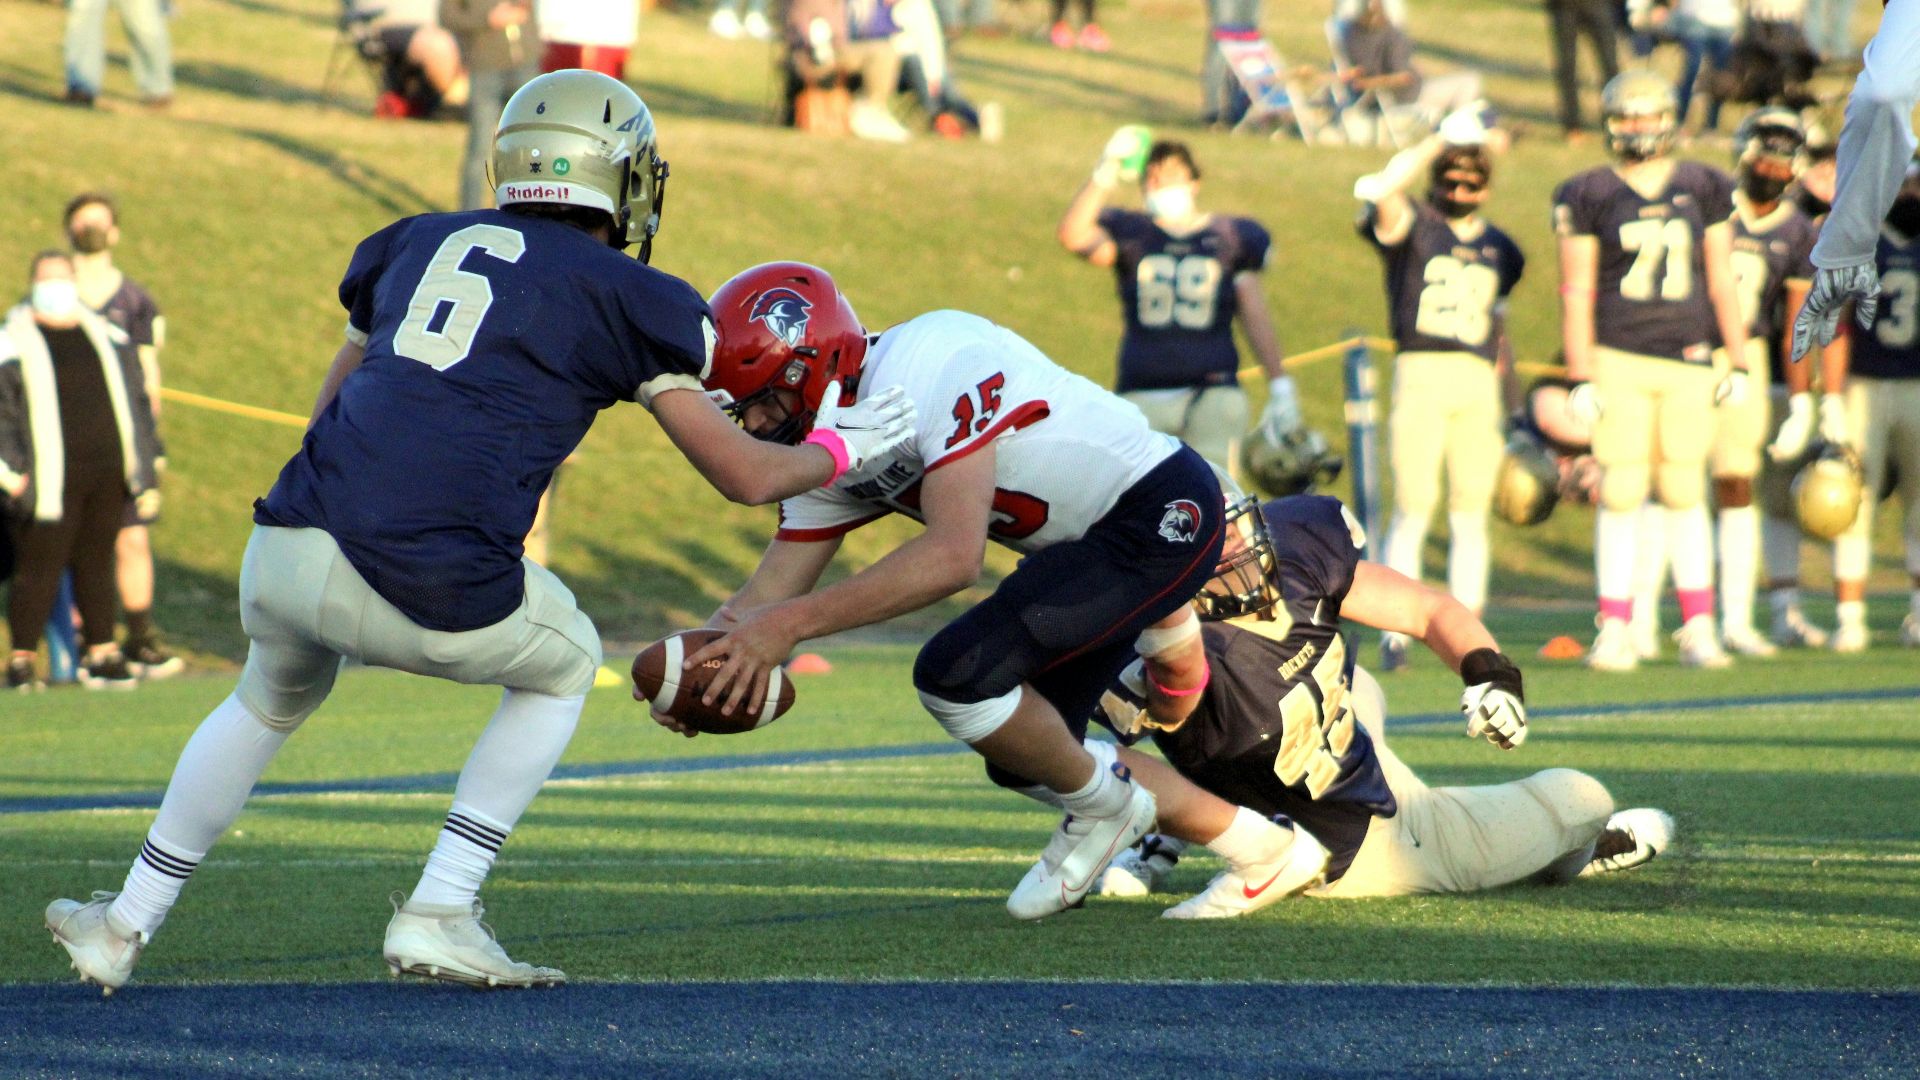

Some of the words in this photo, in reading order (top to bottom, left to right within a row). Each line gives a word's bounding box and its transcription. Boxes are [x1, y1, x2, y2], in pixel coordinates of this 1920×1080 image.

[536, 102, 545, 115] 6
[555, 162, 568, 171] AJ
[393, 223, 526, 372] 6
[1137, 254, 1222, 329] 69
[1619, 218, 1692, 300] 71
[944, 371, 1005, 450] 15
